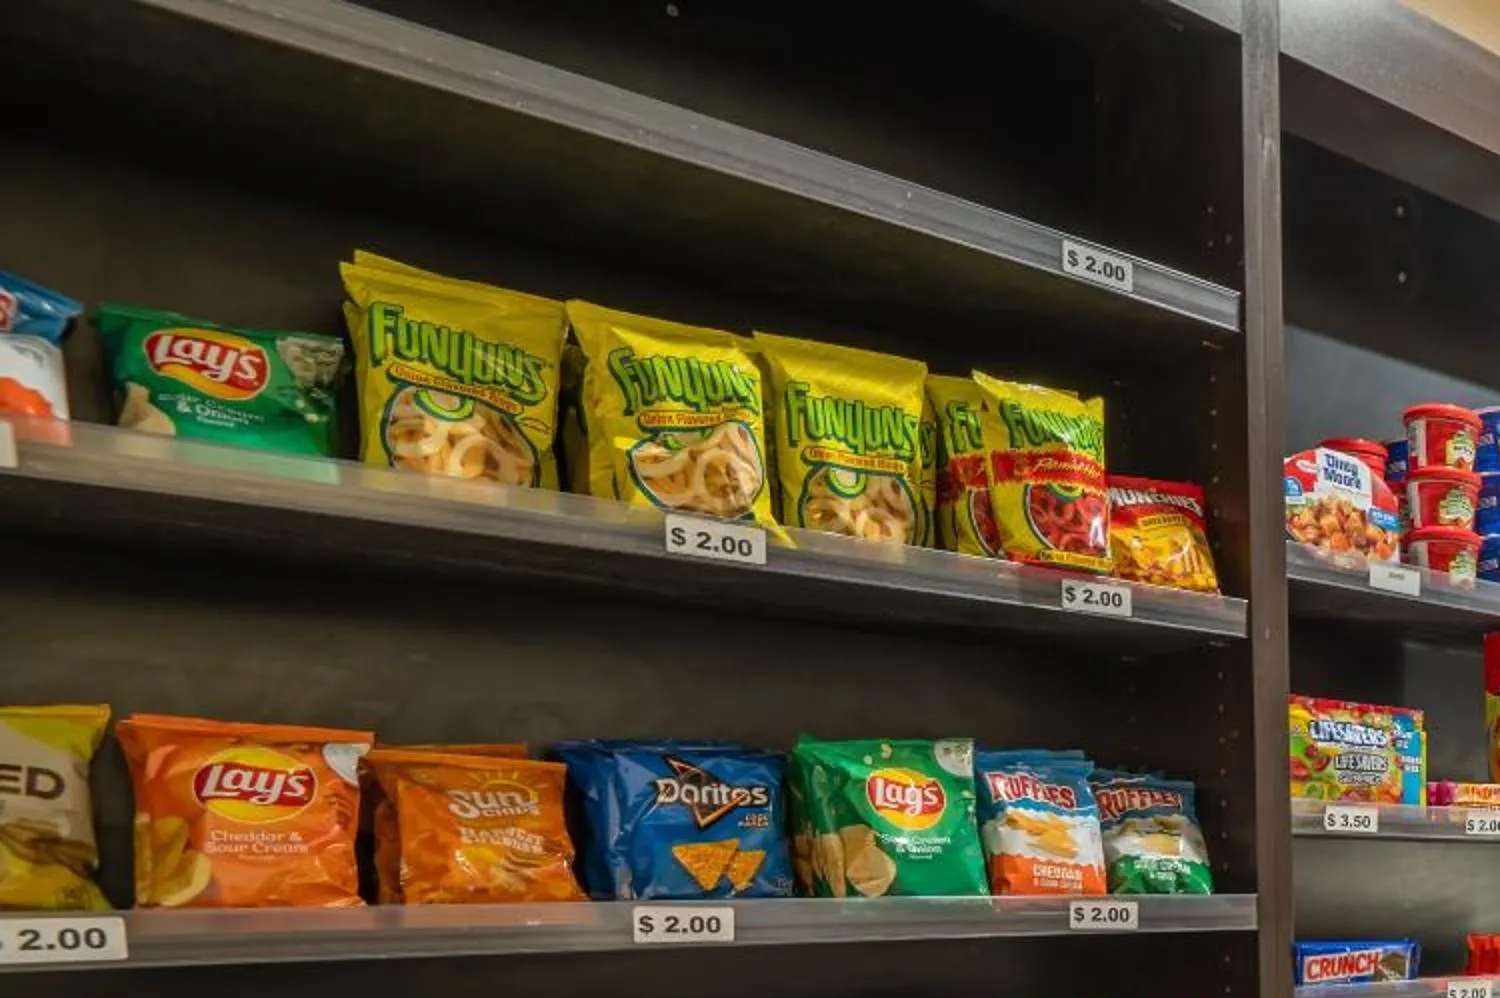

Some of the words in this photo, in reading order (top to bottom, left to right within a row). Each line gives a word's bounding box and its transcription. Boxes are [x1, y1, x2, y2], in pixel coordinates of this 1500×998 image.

[1086, 256, 1126, 282] 2.00
[154, 335, 262, 383] Lay's
[671, 527, 686, 547] $
[696, 531, 753, 557] 2.00
[1082, 590, 1124, 608] 2.00
[201, 764, 308, 806] Lay's
[657, 778, 768, 807] Doritos
[874, 779, 938, 815] Lay's
[1340, 815, 1371, 828] 3.50
[210, 830, 286, 842] Cheddar
[639, 917, 653, 935] $
[665, 915, 721, 935] 2.00
[1091, 907, 1130, 923] 2.00
[18, 927, 107, 952] 2.00
[1306, 951, 1379, 981] CRUNCH
